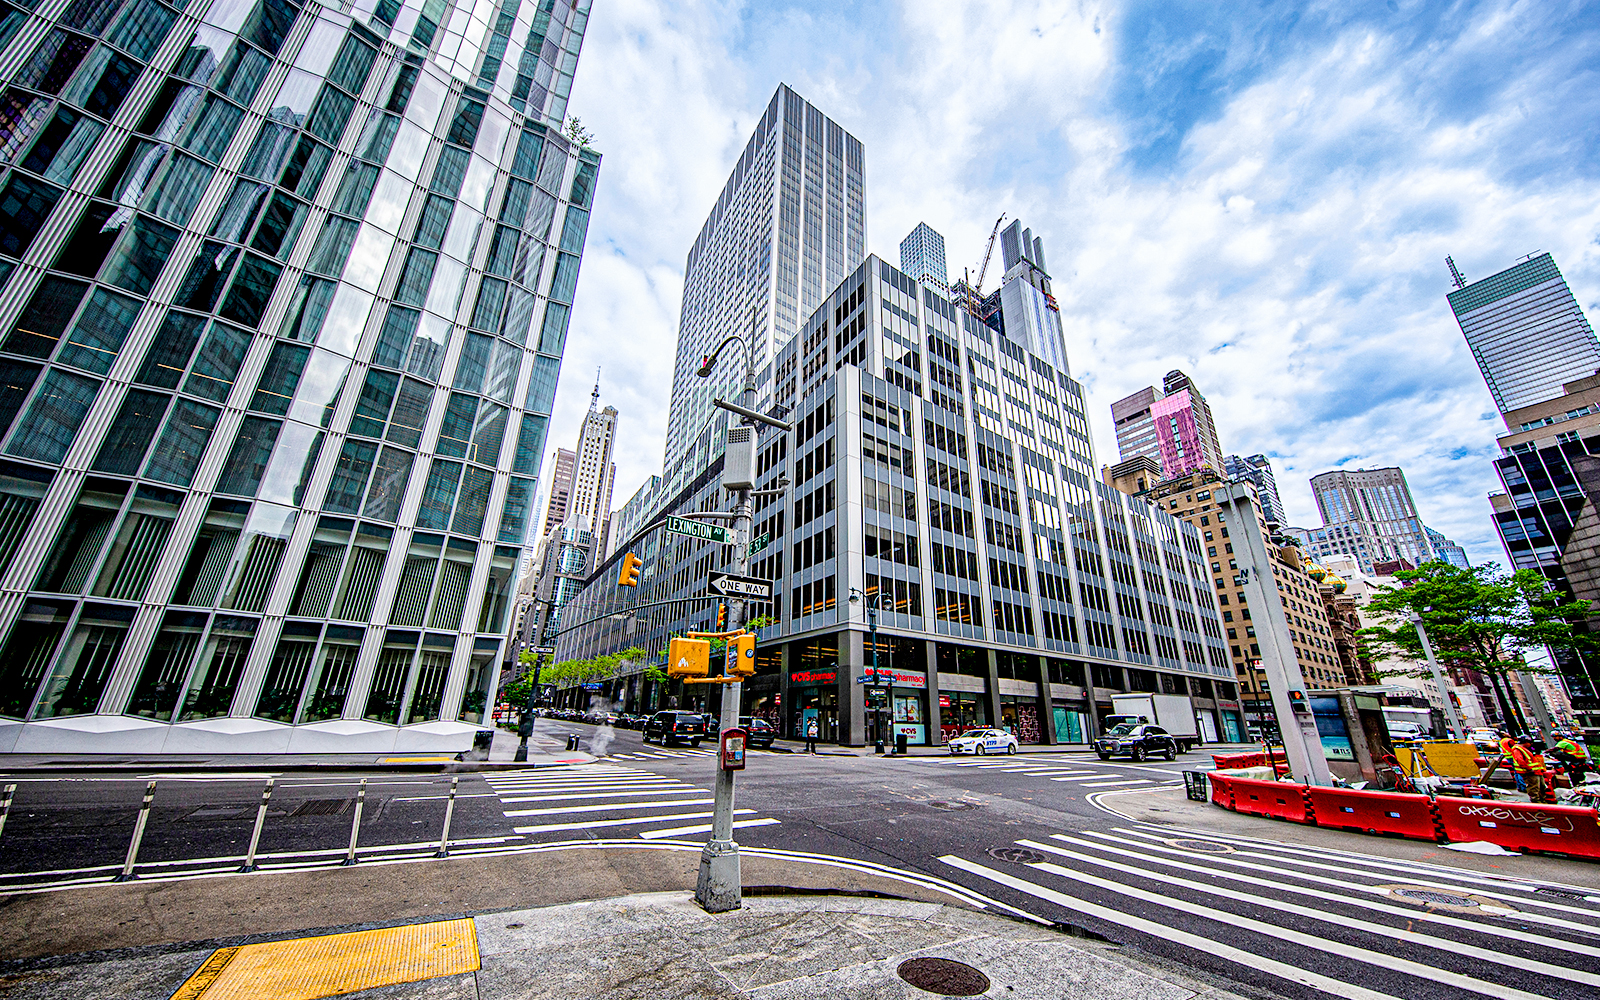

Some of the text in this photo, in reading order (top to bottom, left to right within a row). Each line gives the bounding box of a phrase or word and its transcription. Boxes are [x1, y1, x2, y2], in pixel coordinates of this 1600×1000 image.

[668, 516, 713, 539] LEXINGTON
[754, 538, 762, 552] 53
[720, 580, 765, 595] ONE WAY
[797, 671, 811, 682] CVS
